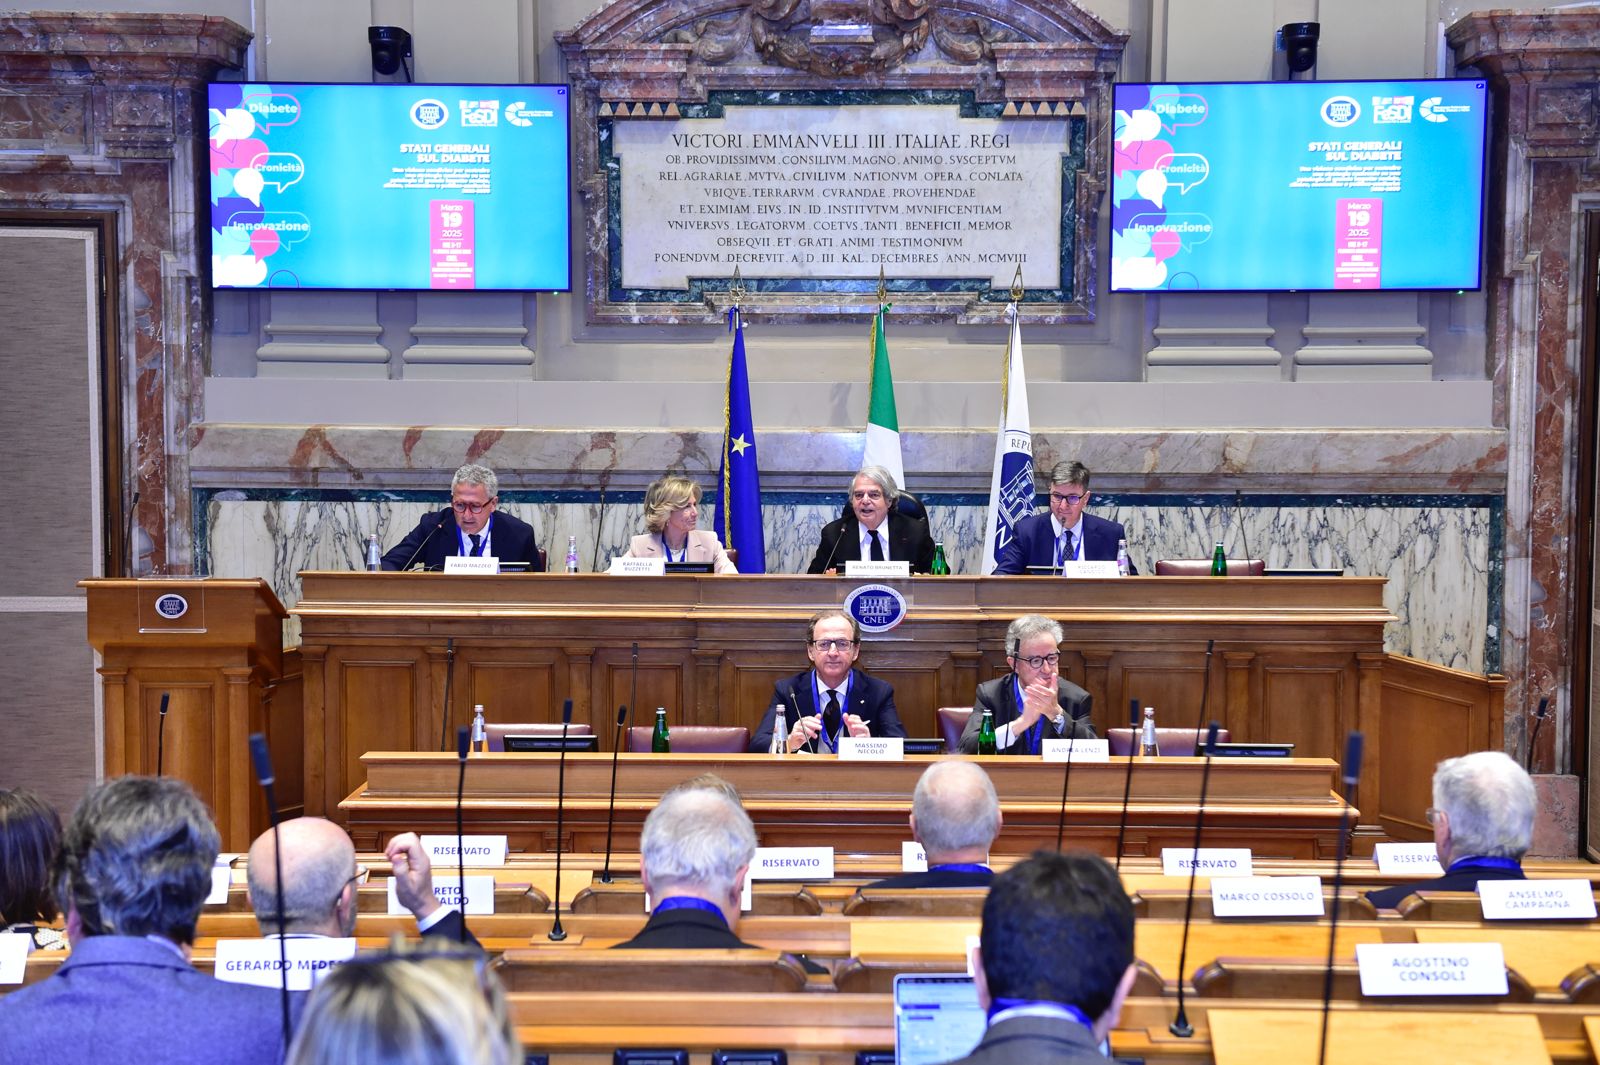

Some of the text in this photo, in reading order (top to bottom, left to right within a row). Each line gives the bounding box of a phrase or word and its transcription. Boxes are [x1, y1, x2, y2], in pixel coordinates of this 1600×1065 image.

[248, 103, 298, 114] Diabete
[1156, 104, 1206, 114] Diabete
[672, 134, 1010, 149] VICTORI EMMANVELI III ITALIAE REGI
[1308, 141, 1402, 152] STATI GENERALI
[400, 143, 490, 153] STATI GENERALI
[417, 154, 491, 164] SUL DIABETE
[665, 155, 1016, 165] OB PROVIDISSIMVM CONSILIVM MAGNO ANIMO SVSCEPTVM
[1325, 151, 1402, 162] SUL DIABETE
[254, 162, 302, 173] Cronicità
[1159, 162, 1207, 174] Cronicità
[659, 171, 1023, 182] REI AGRARIAE MVTVA CIVILIVM NATIONVM OPERA CONLATA
[704, 188, 976, 200] VBIQVE TERRARVM CVRANDAE PROVEHENDAE
[440, 204, 464, 212] Marzo
[679, 204, 1002, 215] ET EXIMIAM EIVS IN ID INSTITVTVM MVNIFICENTIAM
[1347, 202, 1372, 210] Marzo
[441, 212, 463, 228] 19
[1347, 211, 1370, 227] 19
[233, 220, 310, 231] Innovazione
[667, 221, 1013, 231] VNIVERSVS LEGATORVM COETVS TANTI BENEFICII MEMOR
[1134, 222, 1212, 233] Innovazione
[442, 229, 463, 238] 2025
[1347, 228, 1369, 237] 2025
[716, 237, 963, 249] OBSEQVII ET GRATI ANIMI TESTIMONIVM
[654, 253, 720, 263] PONENDVM
[727, 253, 785, 263] DECREVIT
[822, 253, 835, 263] III
[842, 253, 864, 263] KAL
[871, 253, 939, 263] DECEMBRES
[946, 253, 971, 263] ANN
[978, 253, 1027, 263] MCMVIII
[863, 616, 888, 624] CNEL
[762, 858, 820, 867] RISERVATO
[1178, 859, 1237, 868] RISERVATO
[1219, 892, 1314, 901] MARCO COSSOLO
[1508, 890, 1563, 899] ANSELMO
[1505, 900, 1570, 909] CAMPAGNA
[225, 960, 293, 971] GERARDO
[1392, 957, 1469, 968] AGOSTINO
[1399, 971, 1466, 981] CONSOLI
